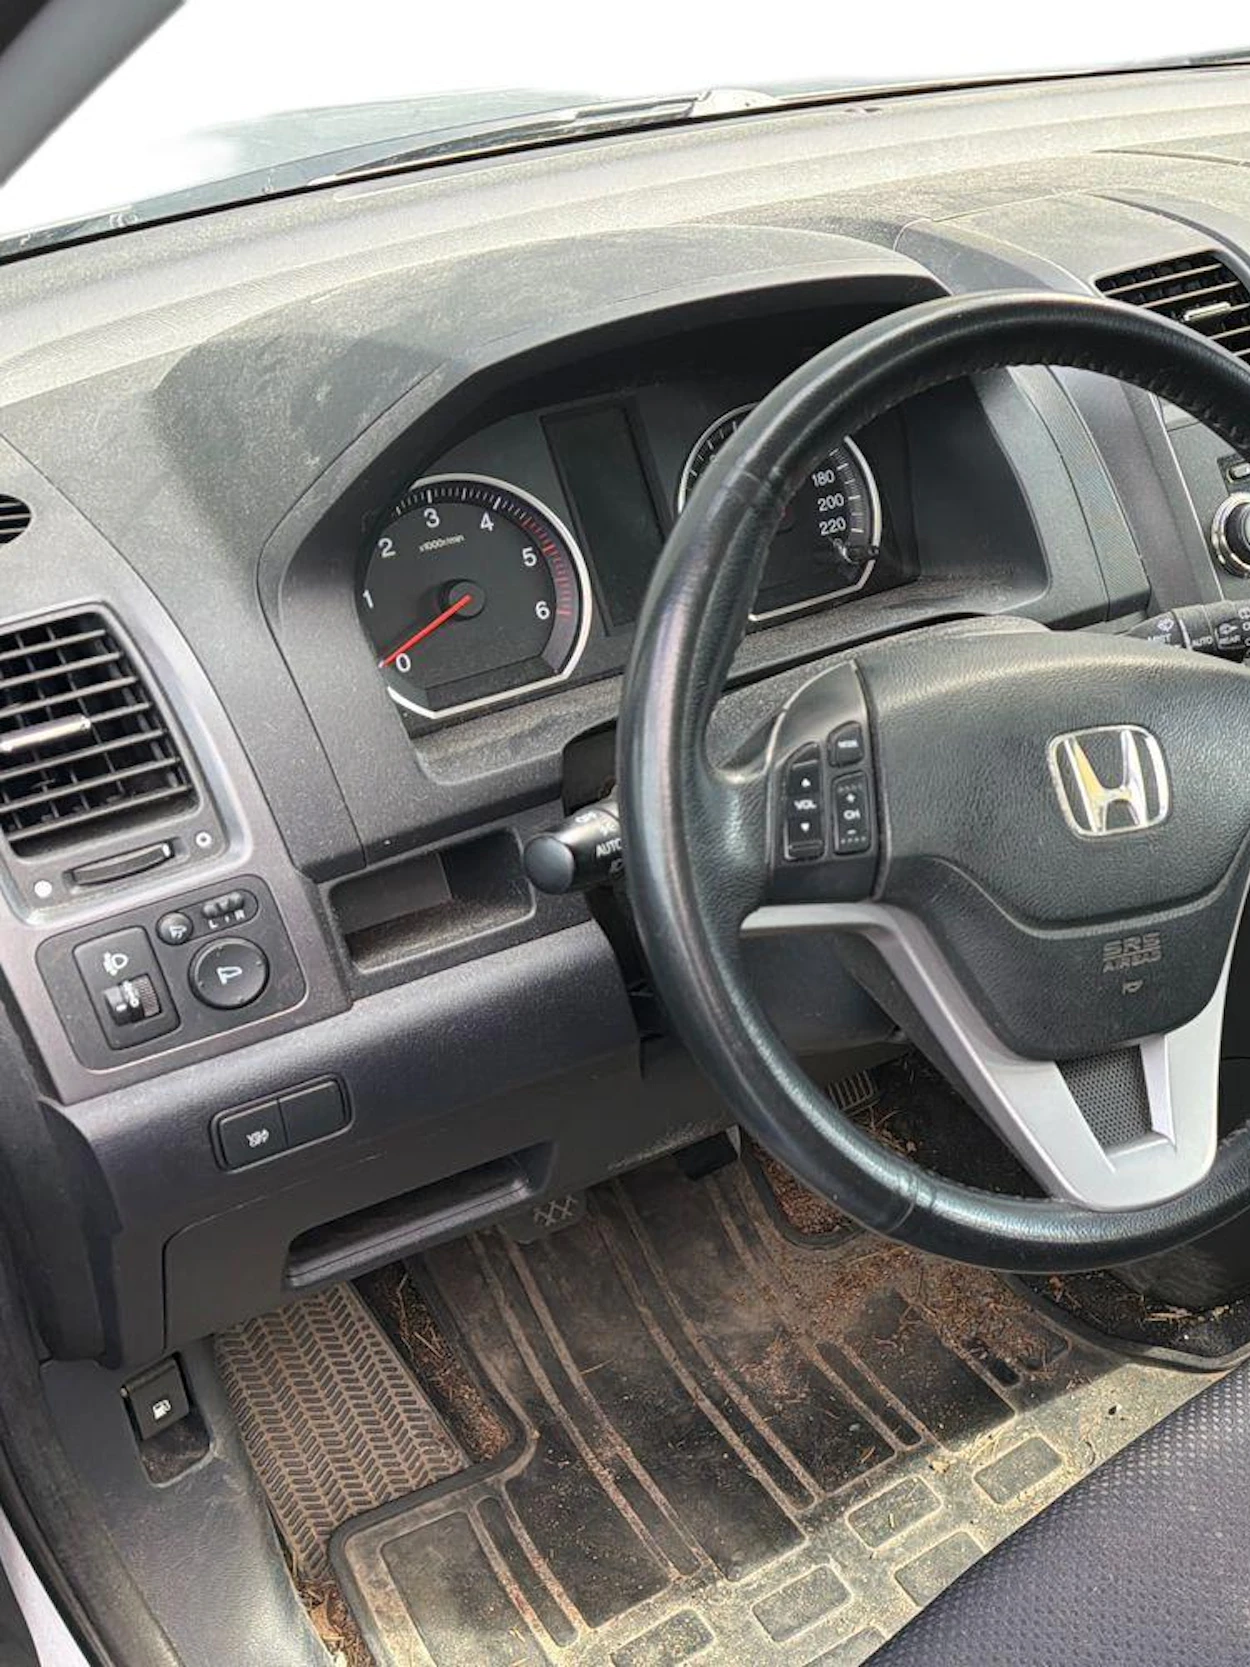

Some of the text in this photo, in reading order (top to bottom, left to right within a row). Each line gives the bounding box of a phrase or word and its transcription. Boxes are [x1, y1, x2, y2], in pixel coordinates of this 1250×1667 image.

[811, 470, 836, 488] 180
[817, 492, 845, 512] 200
[423, 508, 441, 528] 3
[479, 512, 495, 532] 4
[819, 517, 847, 536] 220
[378, 537, 396, 558] 2
[521, 547, 537, 567] 5
[362, 589, 375, 609] 1
[535, 600, 550, 620] 6
[395, 653, 412, 673] 0
[794, 799, 817, 811] VOL
[843, 809, 861, 820] CH
[595, 837, 623, 858] AUTO
[1103, 932, 1162, 955] SRS
